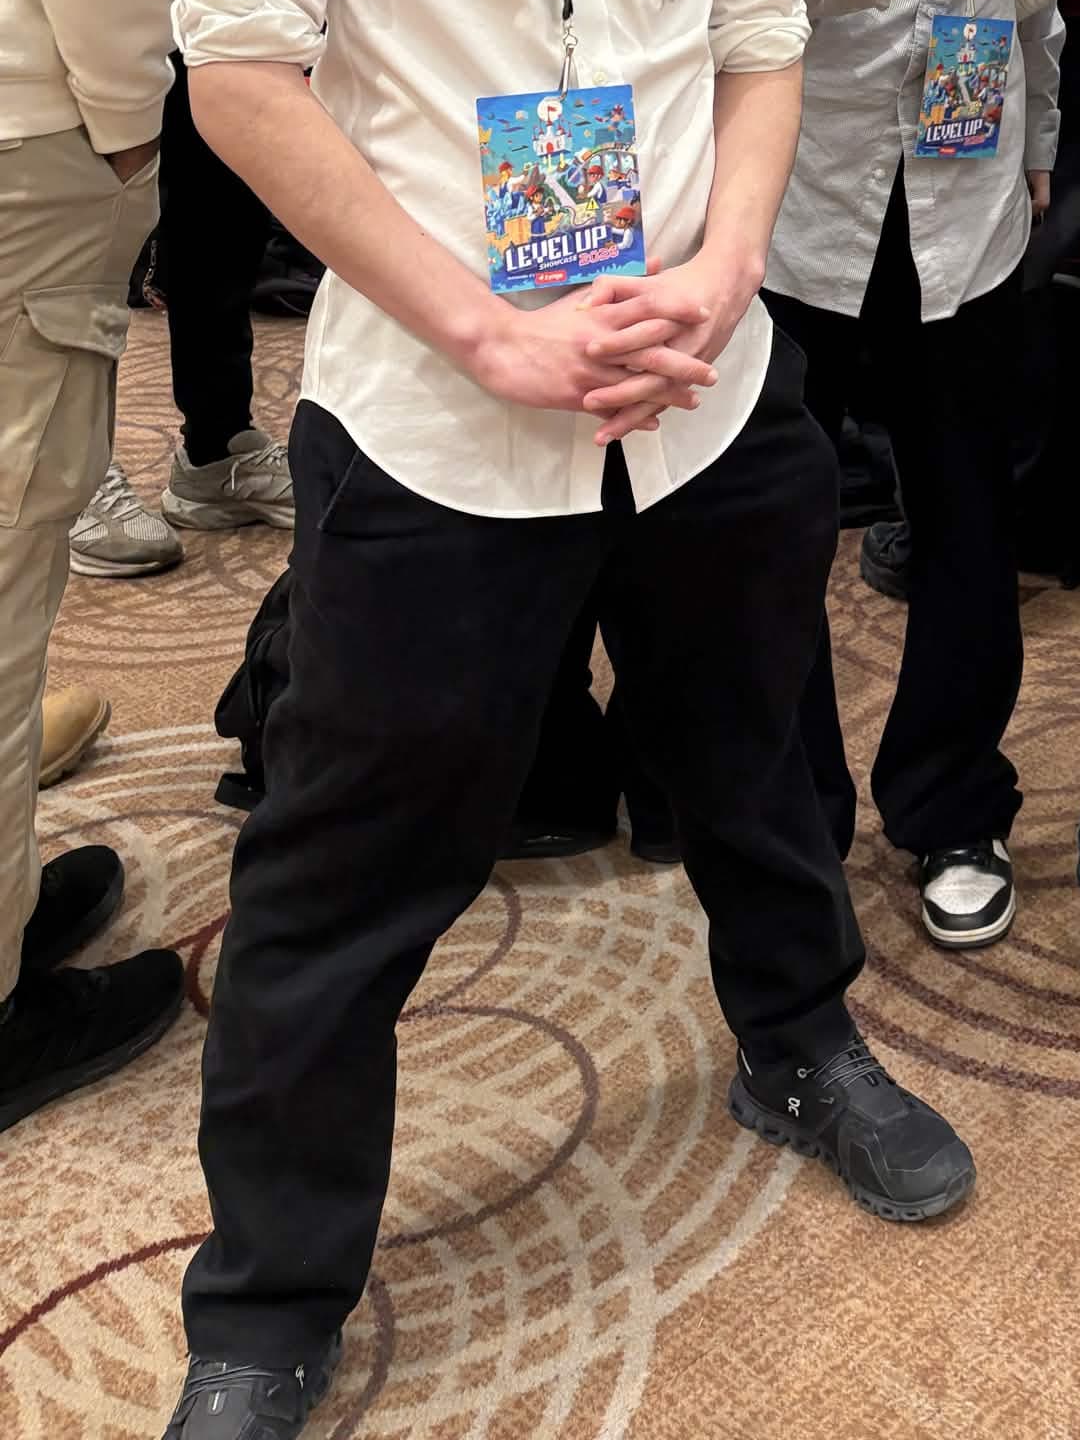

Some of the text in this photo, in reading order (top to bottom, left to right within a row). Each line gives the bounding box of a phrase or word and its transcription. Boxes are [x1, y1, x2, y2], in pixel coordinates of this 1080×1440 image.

[926, 118, 983, 143] LEVEL UP
[506, 225, 607, 272] LEVEL UP
[539, 254, 578, 271] SHOWCASE
